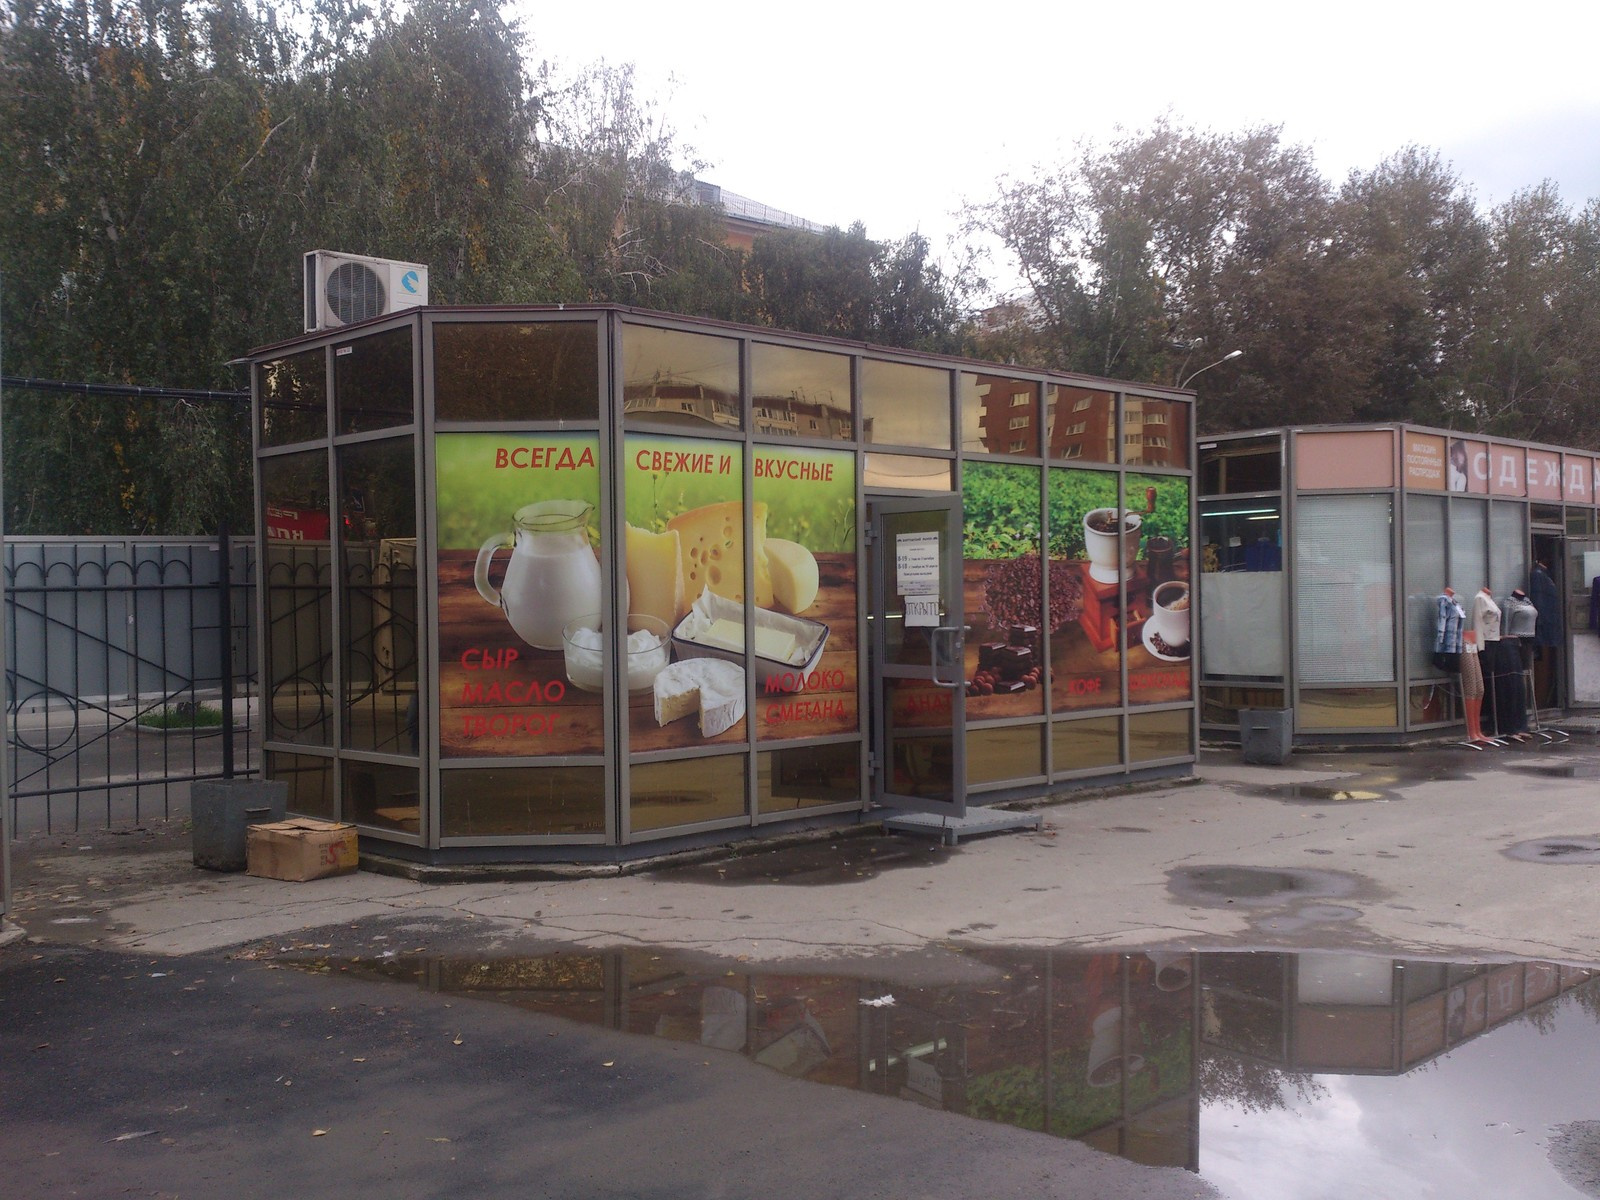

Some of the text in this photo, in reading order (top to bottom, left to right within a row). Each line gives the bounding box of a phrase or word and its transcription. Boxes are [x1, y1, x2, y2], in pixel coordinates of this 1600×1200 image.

[495, 447, 834, 481] ВСЕГДА СВЕЖИЕ И ВКУСНЫЕ
[461, 648, 519, 671] СЫР
[461, 680, 566, 704] МАСЛО
[765, 669, 845, 693] МОЛОКО
[1068, 677, 1101, 695] КОФЕ
[765, 700, 846, 724] СМЕТАНА
[462, 713, 561, 737] ТВОРОГ
